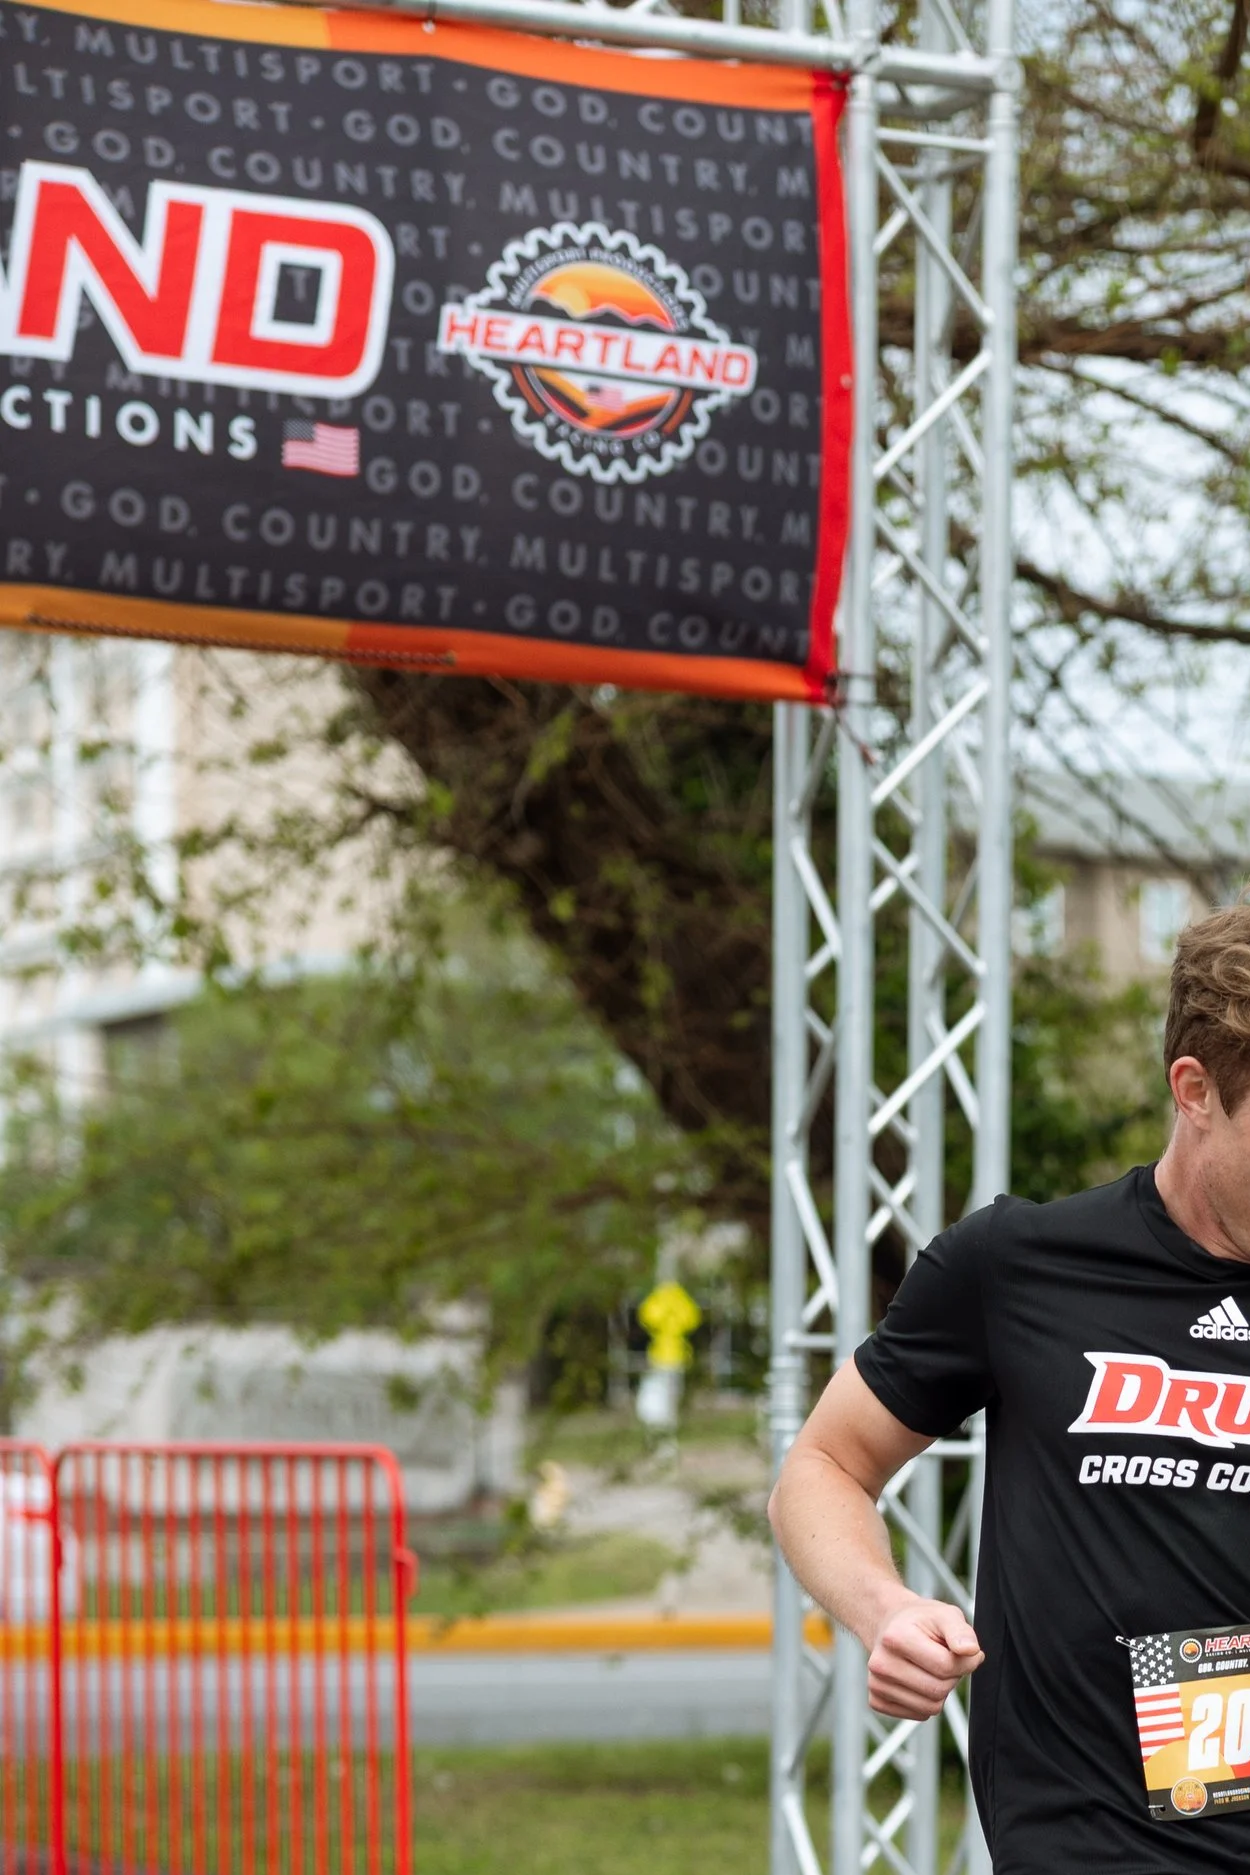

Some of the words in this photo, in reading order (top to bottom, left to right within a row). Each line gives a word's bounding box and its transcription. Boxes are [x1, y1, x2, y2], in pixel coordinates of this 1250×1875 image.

[74, 22, 435, 93] MULTISPORT
[499, 182, 820, 254] MULTISPOR
[0, 159, 395, 398] ND
[440, 307, 755, 392] HEARTLAND
[0, 383, 258, 461] CTIONS
[100, 550, 458, 620] MULTISPORT
[1078, 1454, 1199, 1488] CROSS
